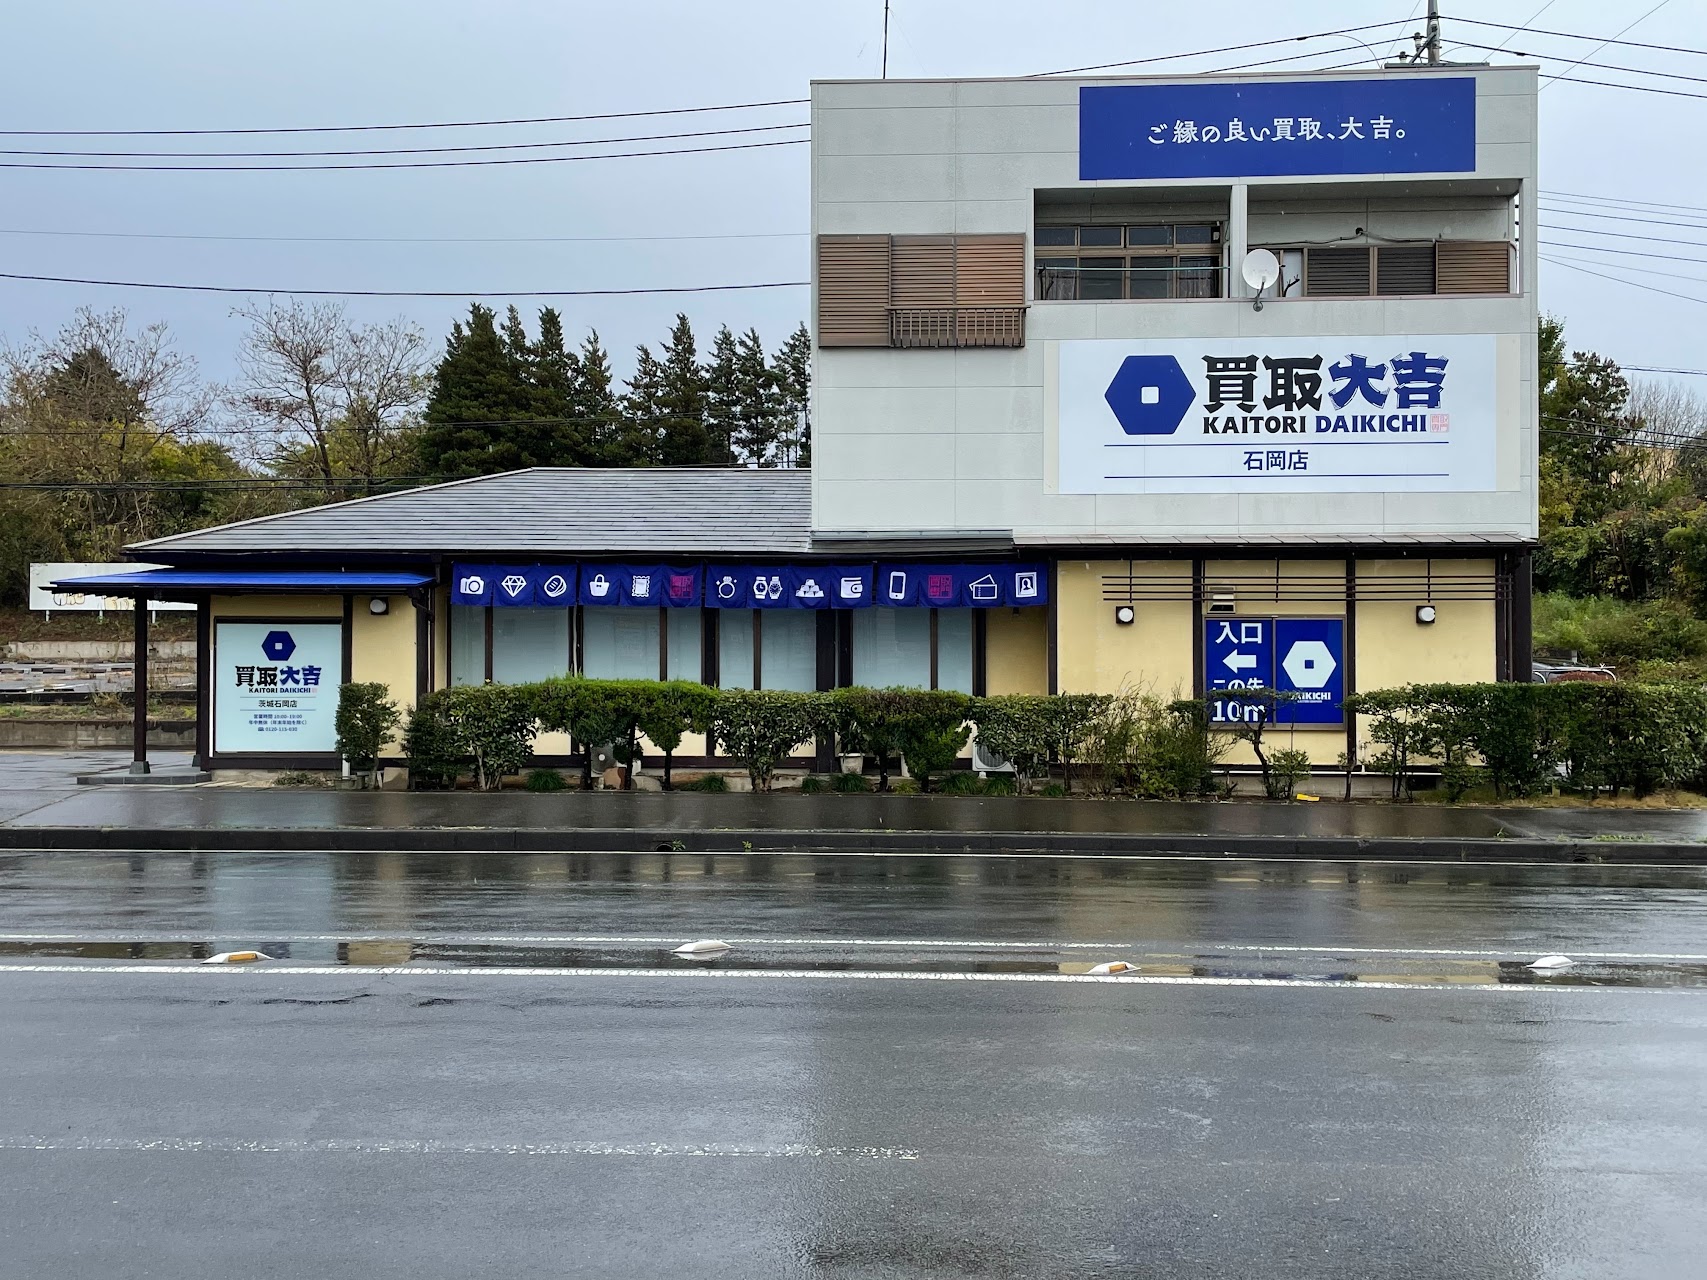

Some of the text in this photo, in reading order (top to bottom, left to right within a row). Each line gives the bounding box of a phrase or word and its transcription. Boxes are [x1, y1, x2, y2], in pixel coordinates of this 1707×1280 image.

[1148, 115, 1406, 145] ご縁の良い買取、大吉。
[1201, 351, 1450, 414] 買取大吉
[1202, 414, 1427, 434] KAITORI DAIKICHI
[1243, 449, 1308, 471] 石岡店
[1215, 621, 1263, 644] 入口
[235, 665, 322, 687] 買取大吉
[1212, 700, 1268, 722] 10m
